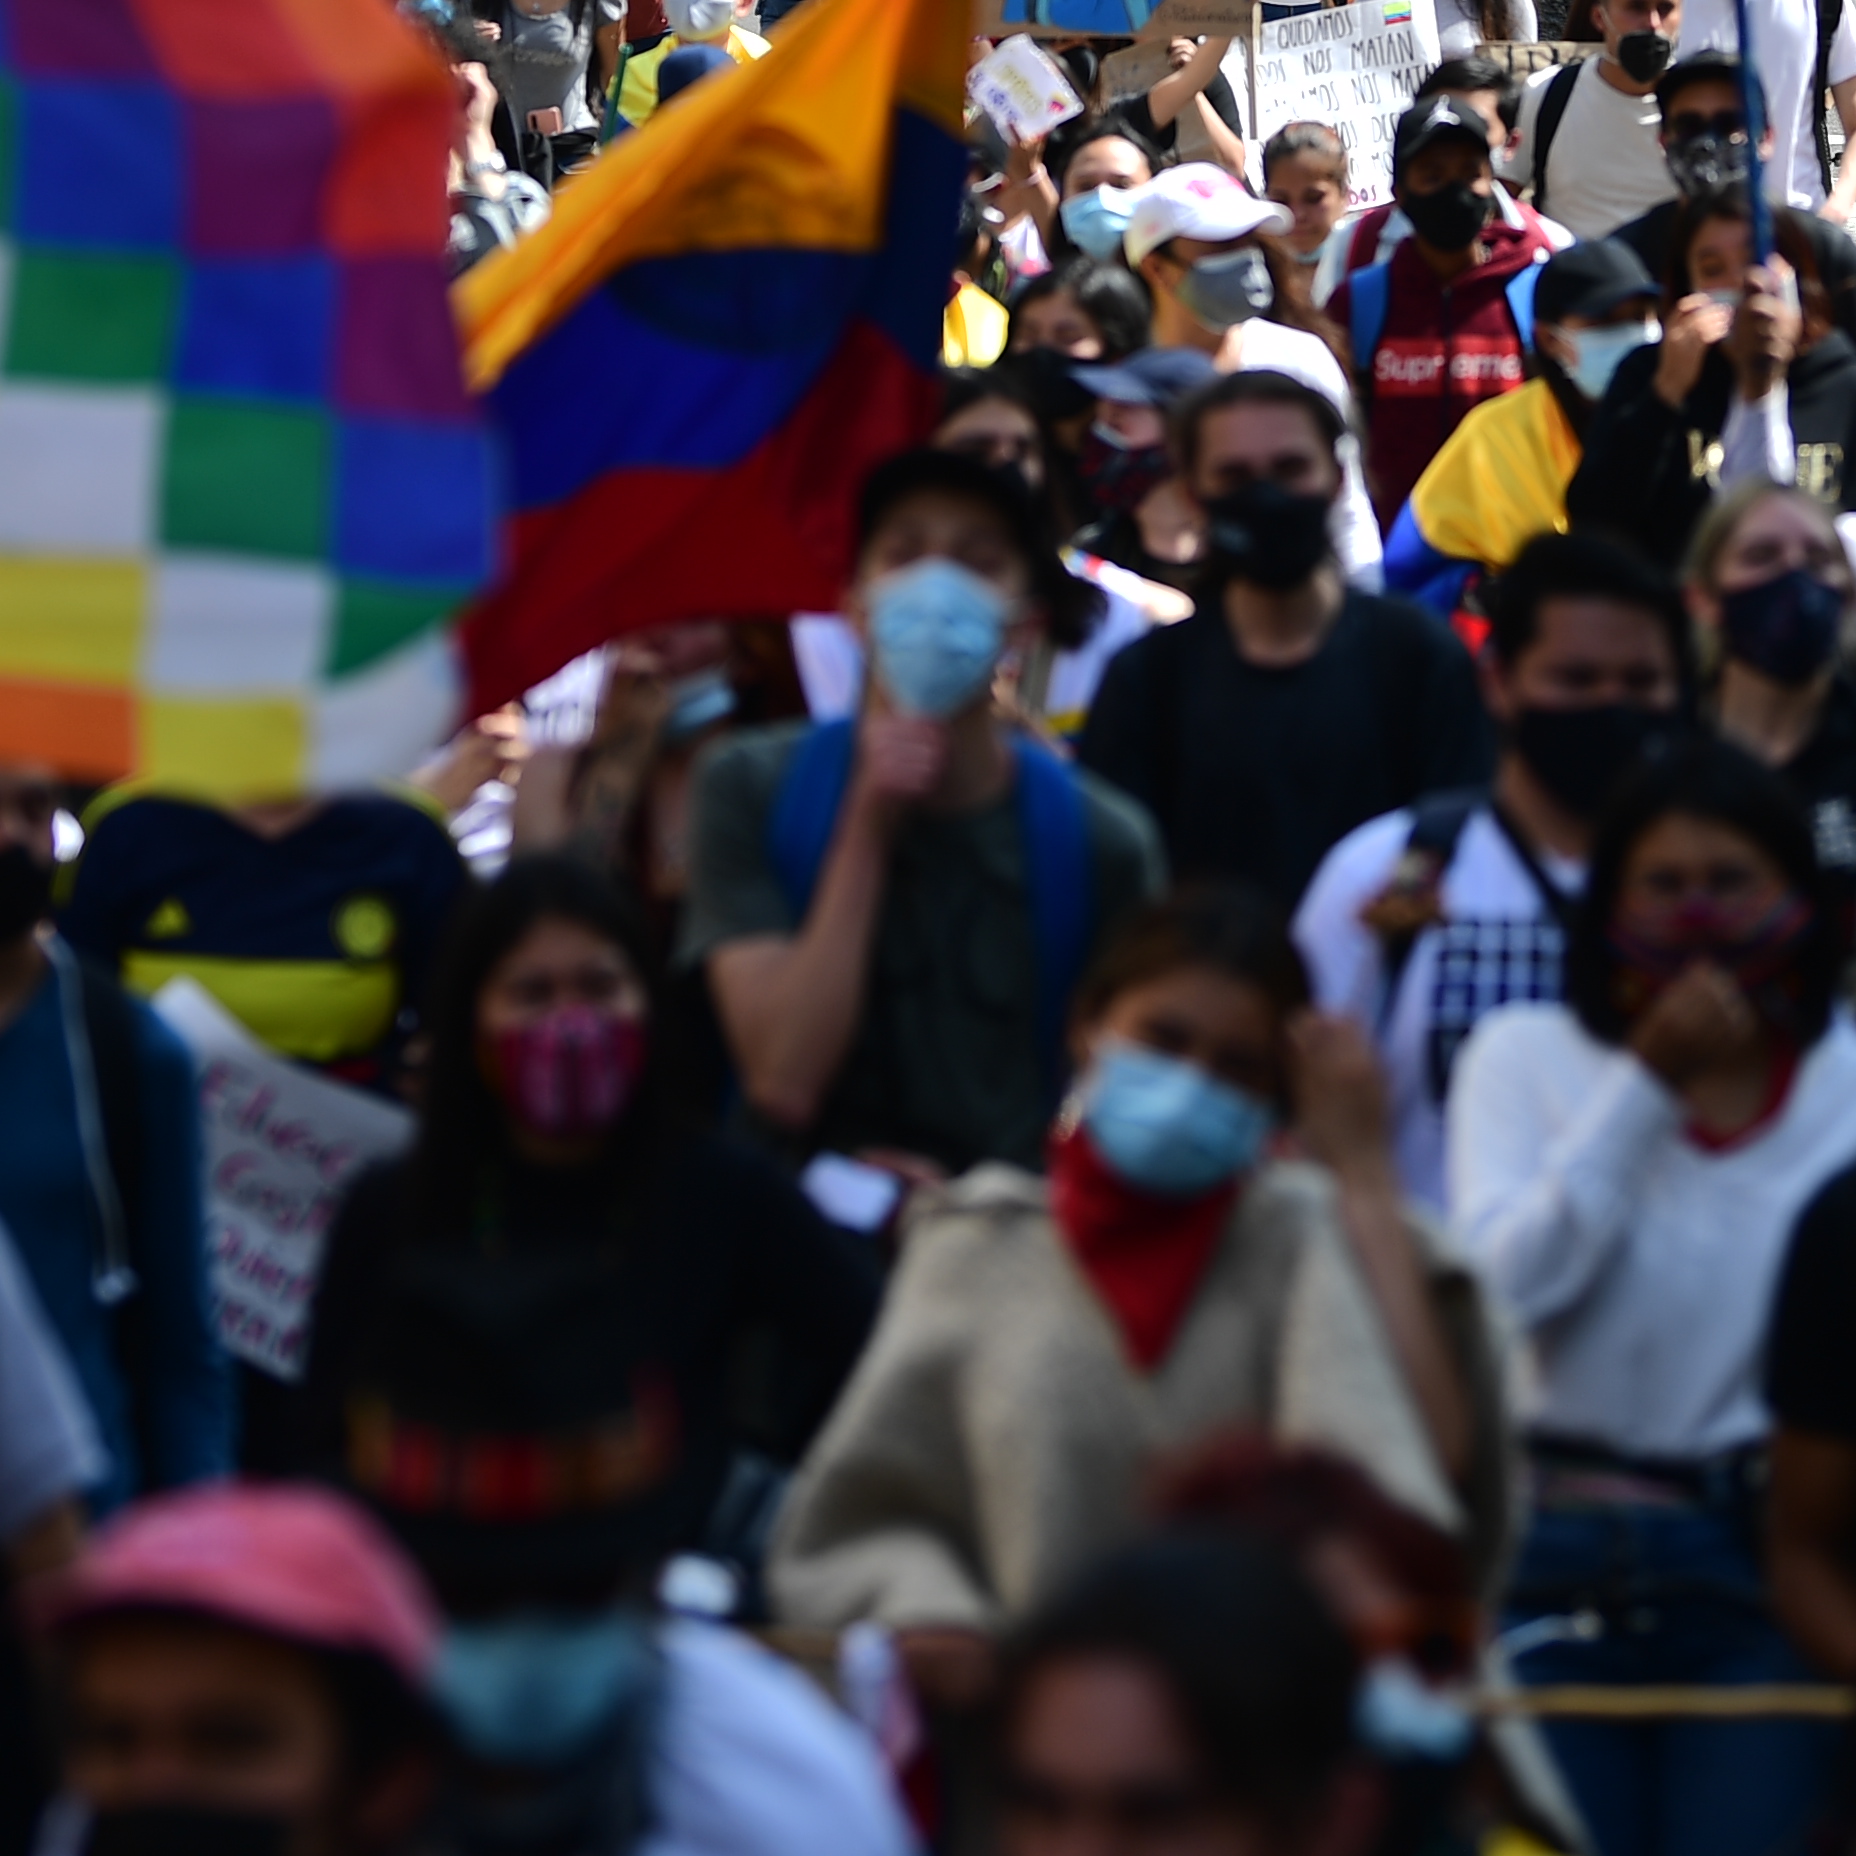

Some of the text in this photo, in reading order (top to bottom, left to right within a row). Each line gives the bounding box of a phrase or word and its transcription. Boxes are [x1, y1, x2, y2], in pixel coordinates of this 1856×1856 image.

[1276, 10, 1355, 50] QUEDAMOS
[1303, 48, 1333, 77] NOS
[1351, 30, 1416, 71] MATAN
[1375, 347, 1522, 387] Supreme
